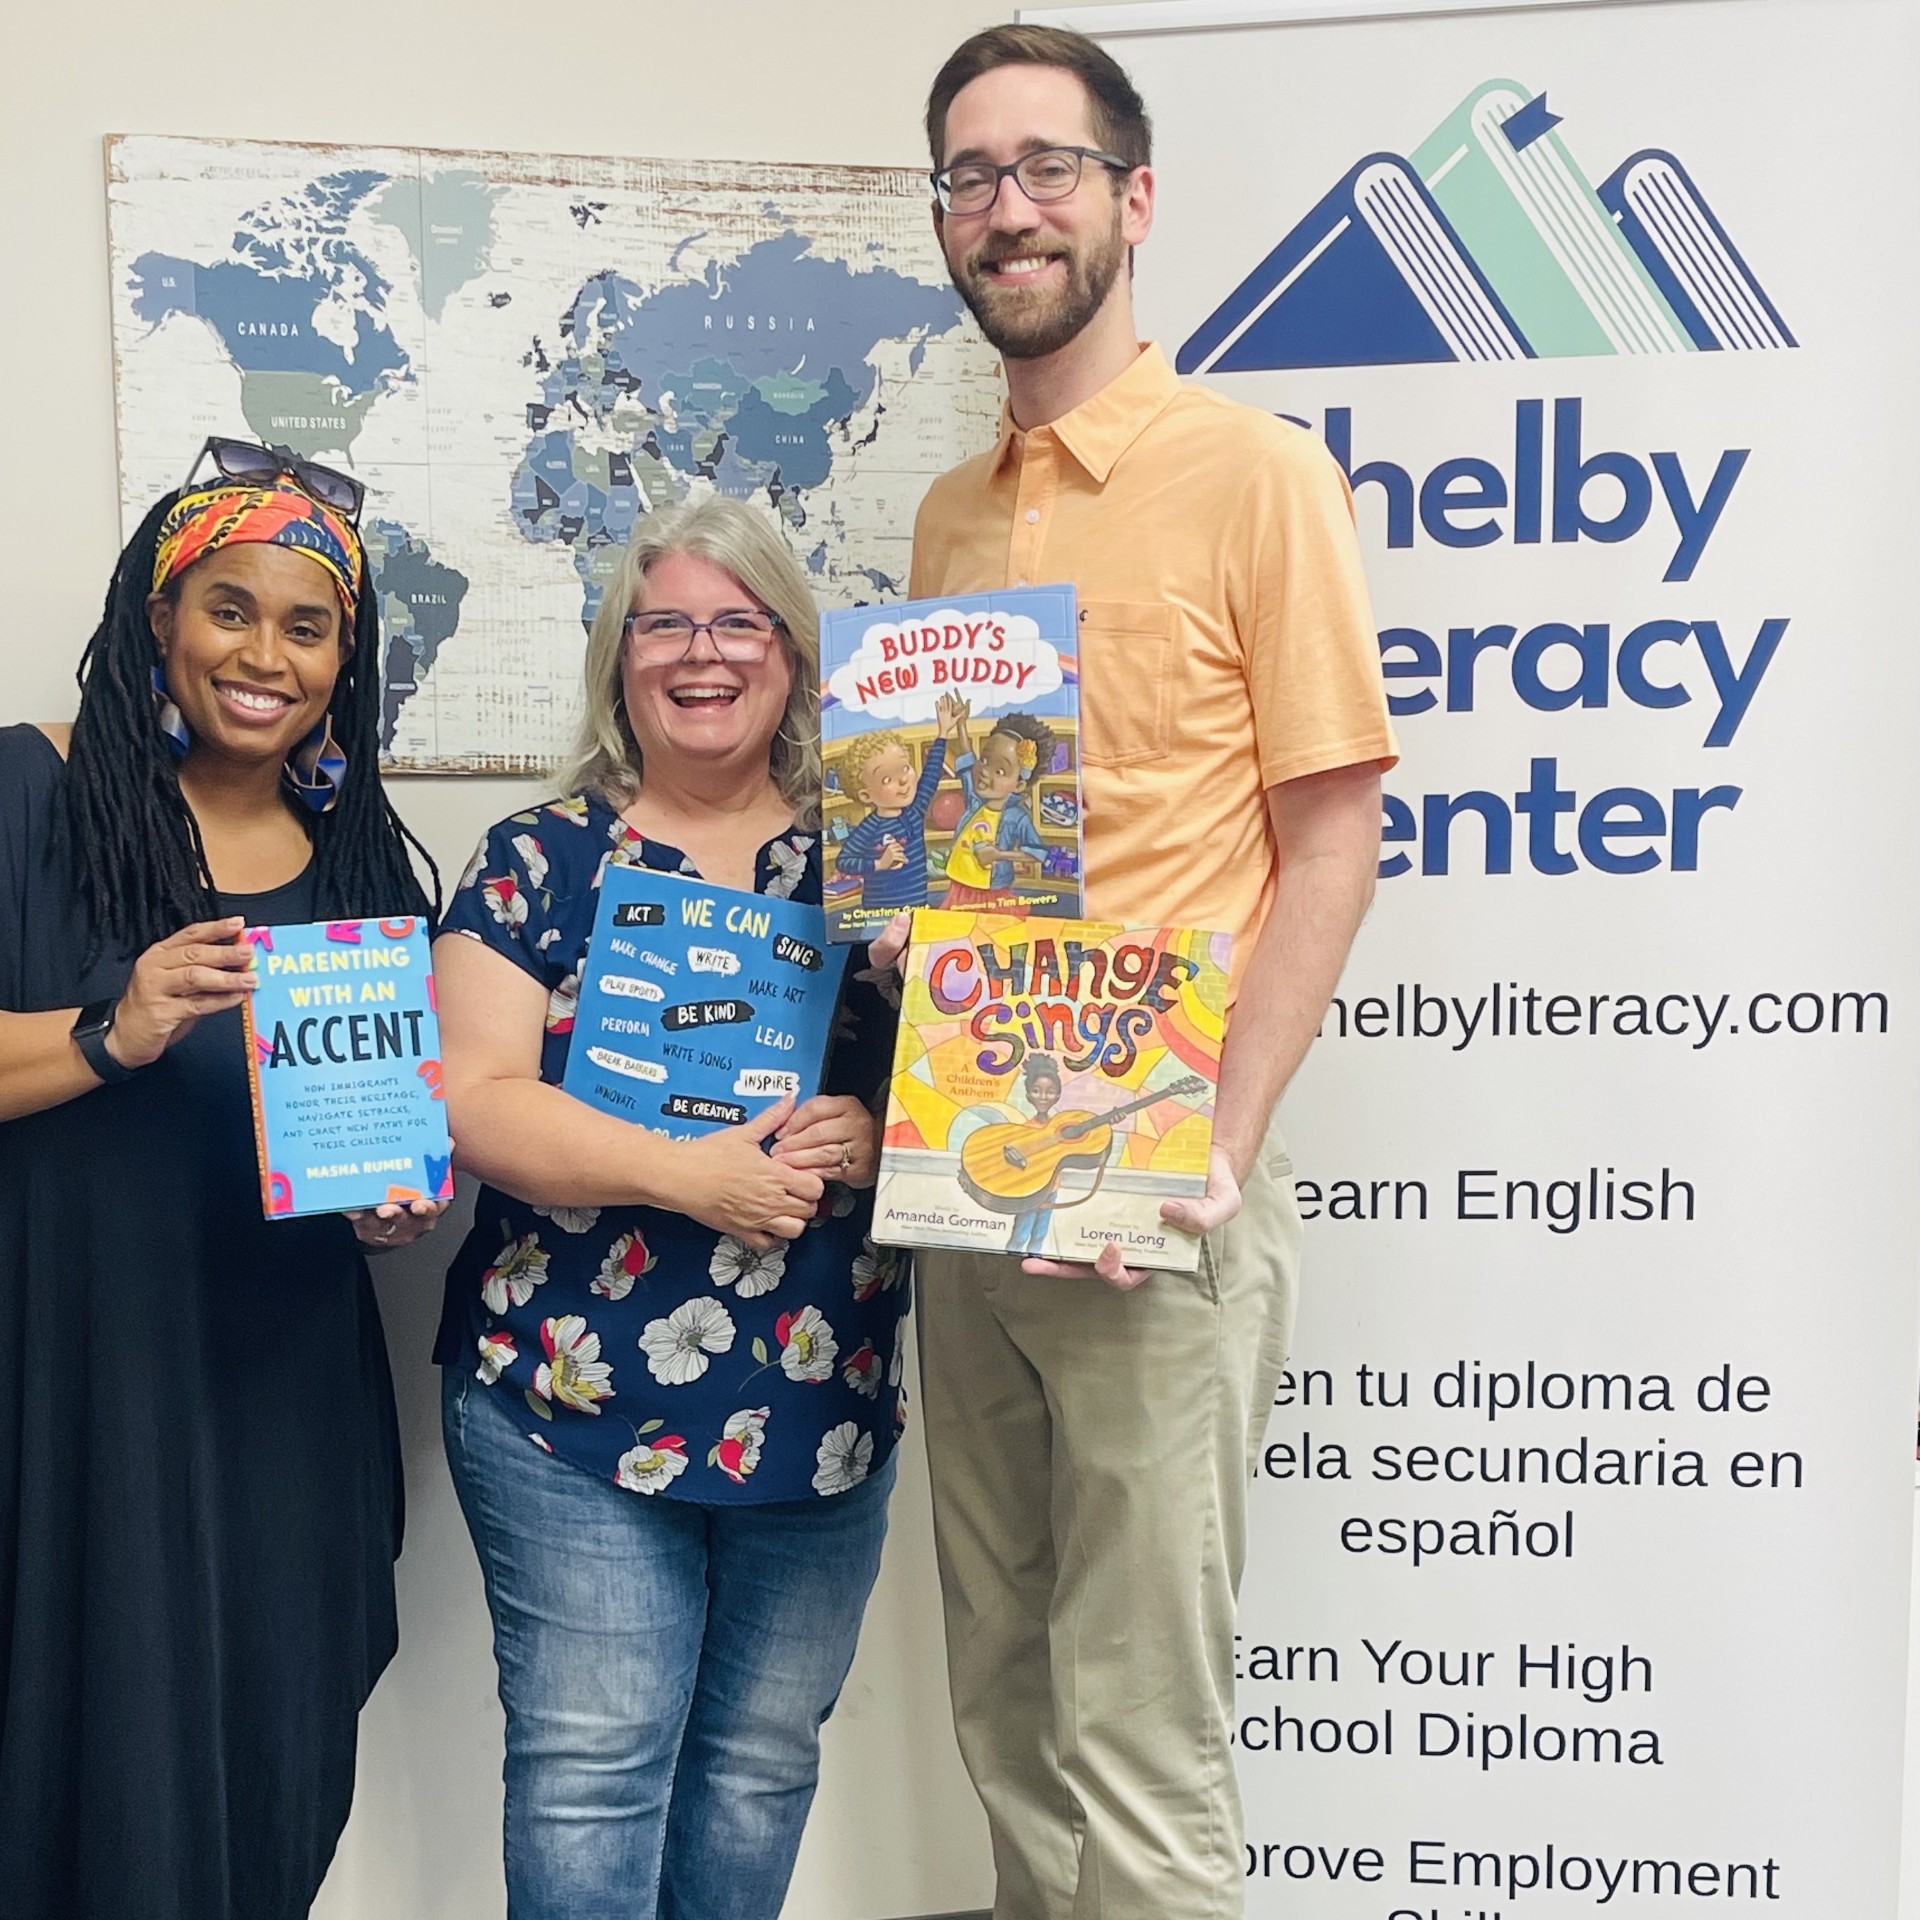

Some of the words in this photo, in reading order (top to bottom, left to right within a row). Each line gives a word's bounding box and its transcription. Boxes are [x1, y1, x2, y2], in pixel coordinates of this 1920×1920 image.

[237, 321, 299, 337] CANADA
[704, 314, 815, 331] RUSSIA
[271, 416, 307, 428] UNITED
[309, 416, 346, 430] STATES
[775, 434, 804, 444] CHINA
[1273, 397, 1751, 582] helby
[411, 593, 447, 604] BRAZIL
[879, 620, 1006, 663] BUDDY'S
[933, 657, 1037, 691] BUDDY
[997, 897, 1016, 907] Tim
[1018, 894, 1058, 906] Bowers
[626, 905, 652, 923] ACT
[681, 897, 716, 928] WE
[725, 905, 771, 939] CAN
[267, 946, 410, 976] PARENTING
[609, 938, 638, 958] MAKE
[640, 950, 679, 976] CHANGE
[696, 950, 731, 970] WRITE
[776, 936, 814, 966] SING
[289, 983, 352, 1008] WITH
[359, 980, 396, 1004] AN
[604, 978, 625, 992] PLAY
[628, 983, 659, 1000] SPORTS
[748, 979, 779, 998] MAKE
[783, 985, 806, 1005] ART
[600, 1016, 650, 1037] PERFORM
[677, 1005, 699, 1025] BE
[269, 1009, 424, 1069] ACCENT
[755, 1025, 795, 1051] LEAD
[662, 1042, 694, 1063] WRITE
[699, 1051, 733, 1071] SONGS
[961, 1063, 969, 1073] A
[304, 1084, 326, 1093] HOW
[331, 1077, 399, 1092] IMMIGRANTS
[946, 1073, 1000, 1087] Children's
[285, 1099, 320, 1110] HONOR
[324, 1097, 357, 1106] THEIR
[595, 1083, 638, 1111] INNOVATE
[949, 1086, 994, 1099] Anthem
[297, 1110, 354, 1123] NAVIGATE
[673, 1098, 689, 1114] BE
[692, 1102, 741, 1122] CREATIVE
[282, 1129, 304, 1139] AND
[308, 1126, 342, 1137] CHART
[347, 1123, 369, 1133] NEW
[407, 1118, 428, 1127] FOR
[313, 1140, 346, 1150] THEIR
[306, 1163, 360, 1179] MASHA
[362, 1157, 413, 1174] RUMER
[1457, 1167, 1695, 1233] English
[885, 1208, 945, 1225] Amanda
[948, 1214, 1007, 1231] Gorman
[1080, 1226, 1123, 1243] Loren
[1128, 1231, 1166, 1249] Long
[1356, 1363, 1408, 1407] tu
[1434, 1360, 1675, 1422] diploma
[1697, 1363, 1772, 1413] de
[1253, 1431, 1352, 1480] ela
[1371, 1436, 1708, 1488] secundaria
[1730, 1451, 1803, 1489] en
[1340, 1509, 1574, 1567] español
[1361, 1638, 1496, 1688] Your
[1518, 1643, 1653, 1704] High
[1230, 1706, 1393, 1756] chool
[1419, 1712, 1664, 1771] Diploma
[1410, 1840, 1781, 1904] Employment
